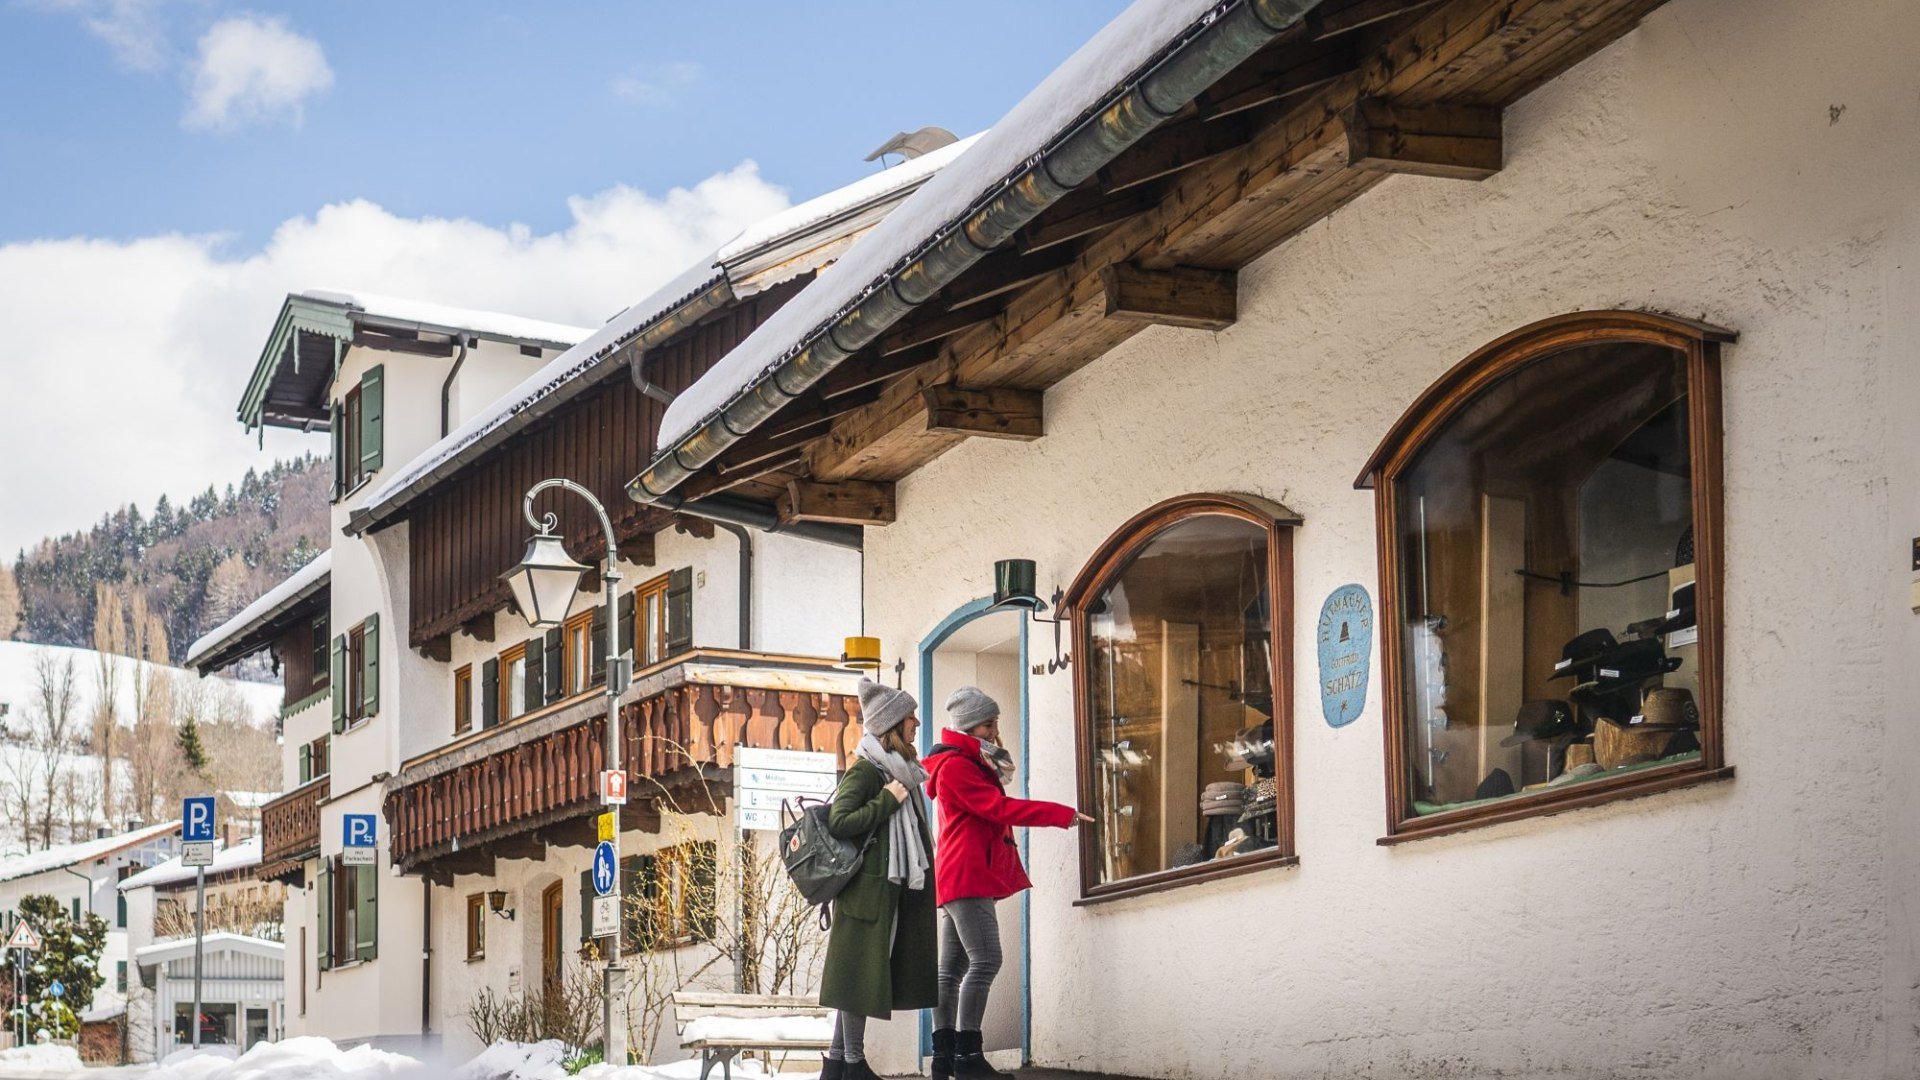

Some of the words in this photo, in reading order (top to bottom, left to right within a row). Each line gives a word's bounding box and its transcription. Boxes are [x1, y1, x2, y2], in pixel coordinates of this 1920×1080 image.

[1322, 592, 1369, 643] HUTMACHER
[190, 802, 208, 837] P
[350, 818, 369, 845] P
[744, 812, 758, 822] WC
